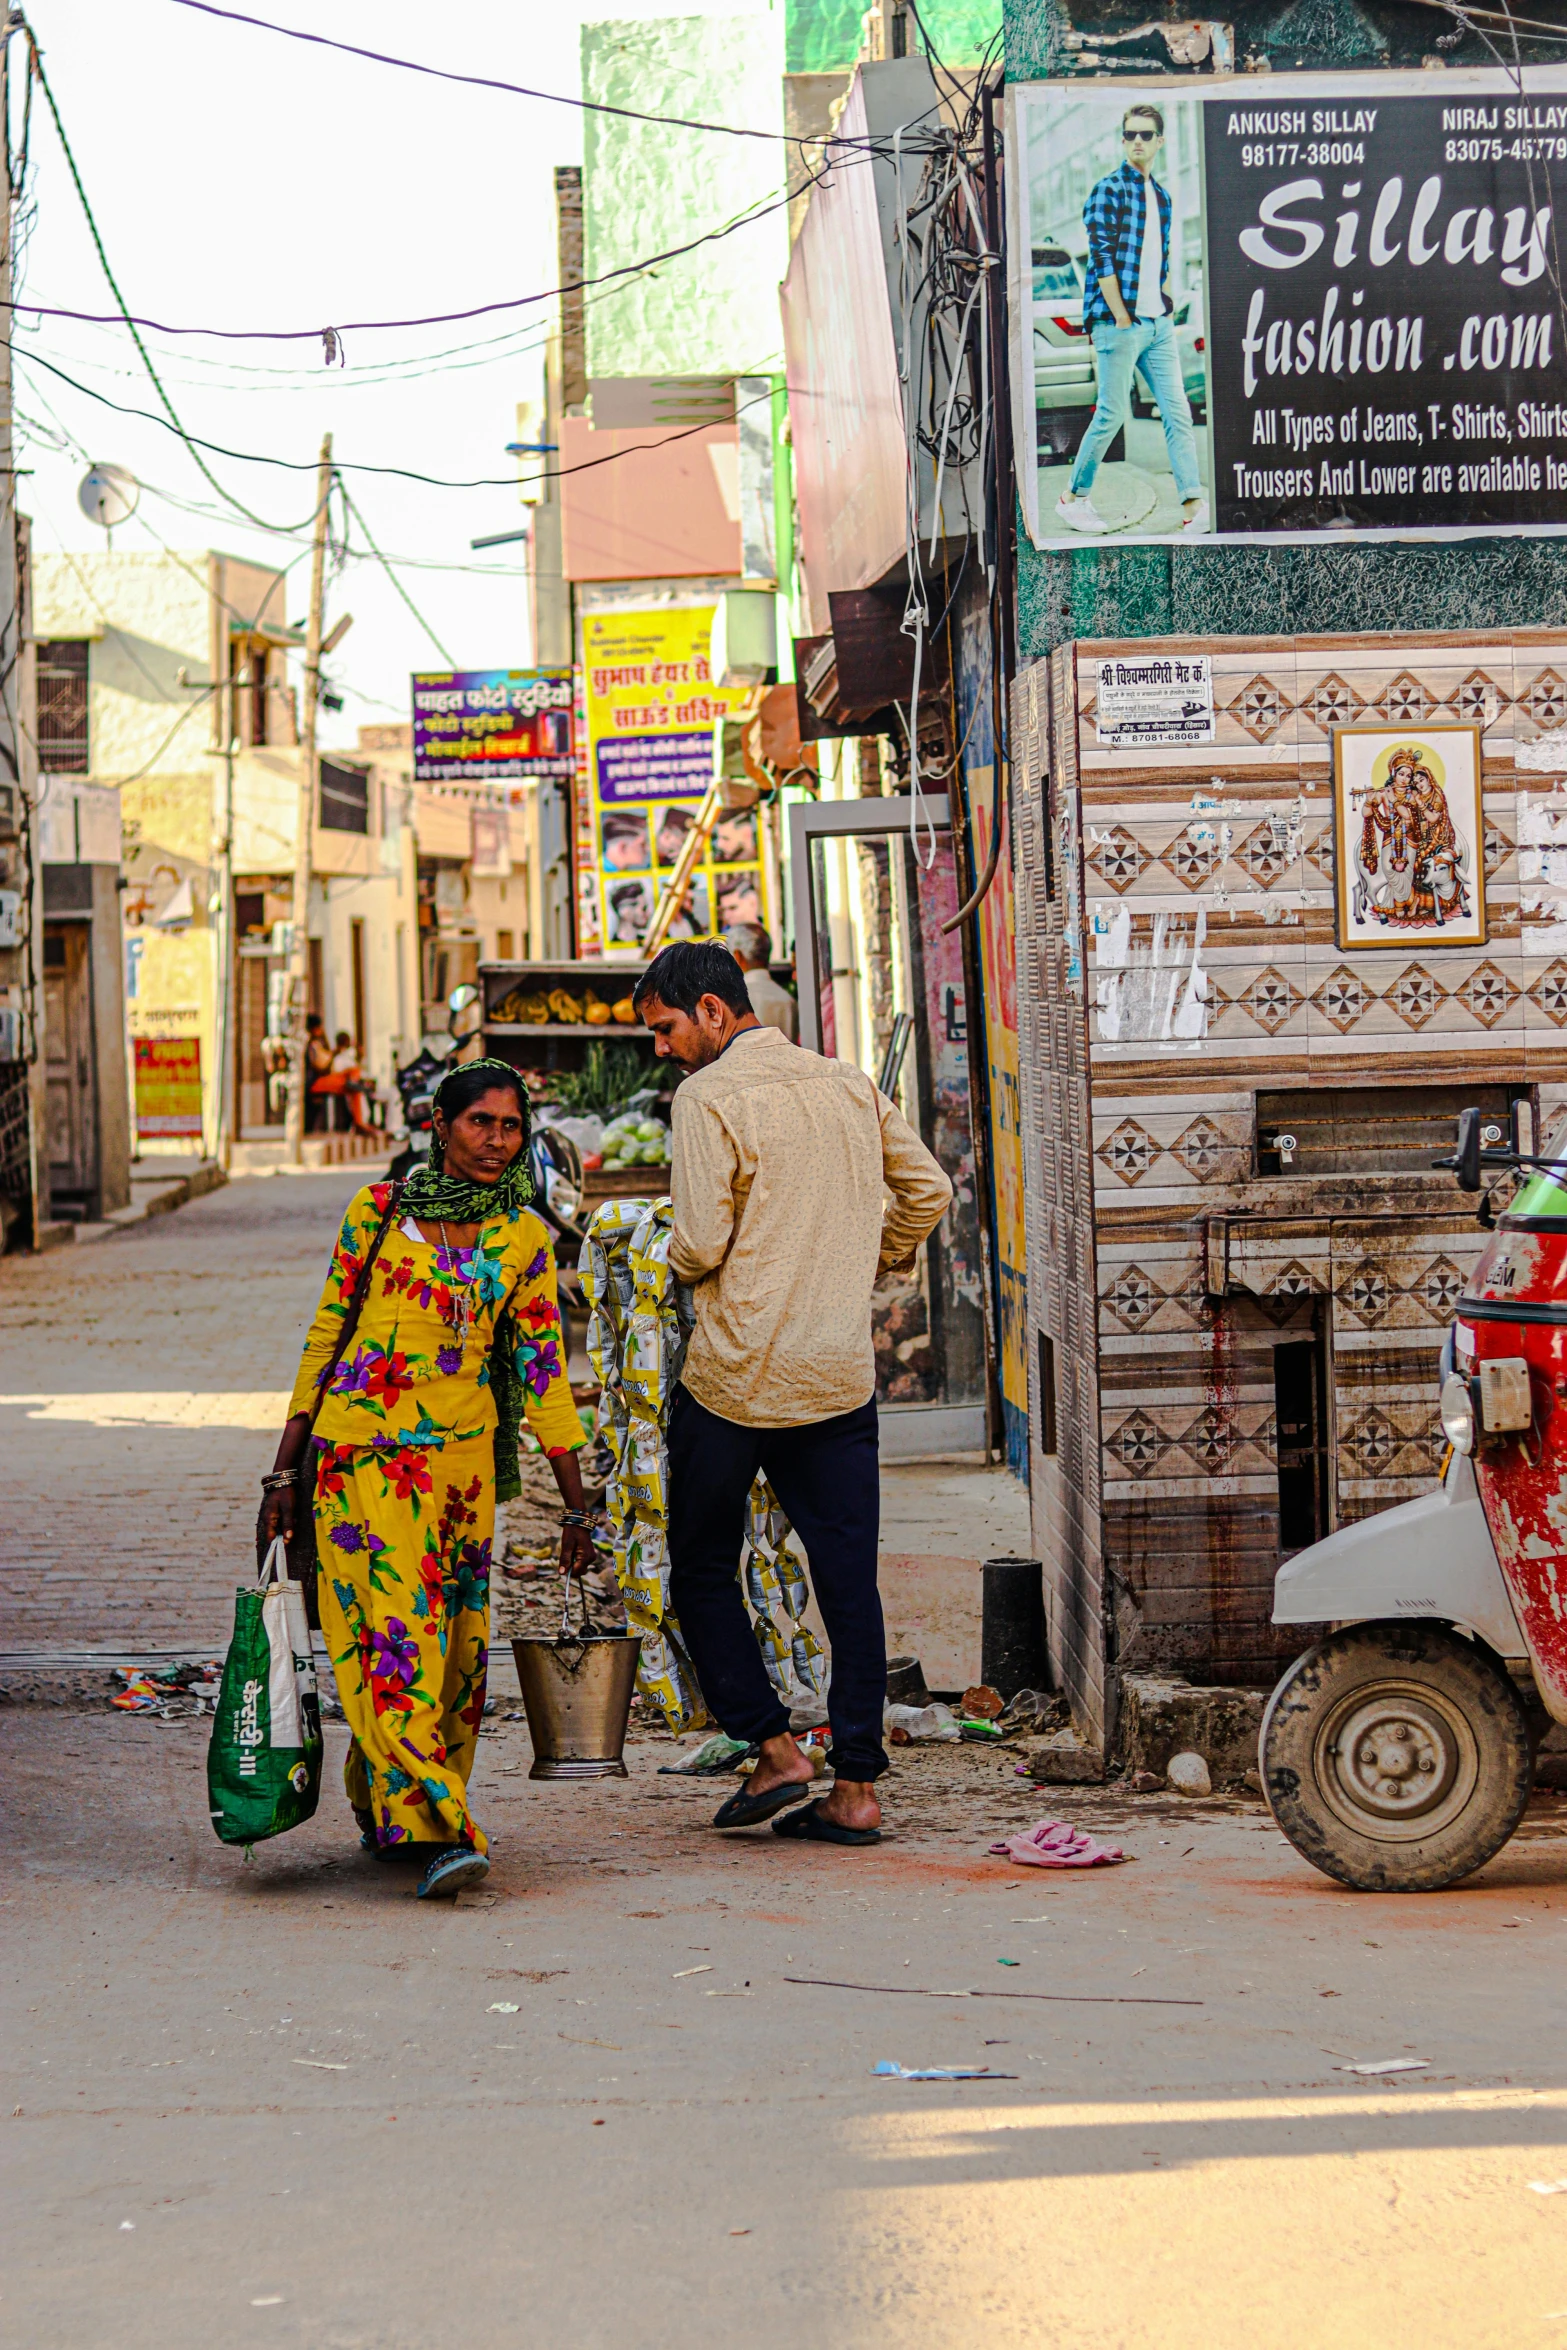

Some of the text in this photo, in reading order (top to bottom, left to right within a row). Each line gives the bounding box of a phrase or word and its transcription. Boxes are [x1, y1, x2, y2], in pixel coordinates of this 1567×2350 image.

[1227, 109, 1378, 135] ANKUSH SILLAY
[1443, 106, 1567, 131] NIRAJ SILLAY
[1241, 142, 1365, 166] 98177-38004
[1445, 138, 1567, 161] 83075-45779
[1238, 176, 1551, 287] Sillay
[1241, 286, 1424, 399] fashion
[1252, 409, 1277, 445] All
[1281, 408, 1335, 452] Types
[1340, 407, 1359, 443] of
[1362, 406, 1424, 447] Jeans,
[1452, 403, 1513, 444] Shirts,
[1233, 462, 1314, 499] Trousers
[1318, 460, 1354, 496] And
[1360, 459, 1417, 495] Lower
[1422, 465, 1452, 493] are
[1458, 455, 1542, 493] available
[1101, 664, 1113, 686] श्री
[1131, 732, 1200, 742] 87081-68068
